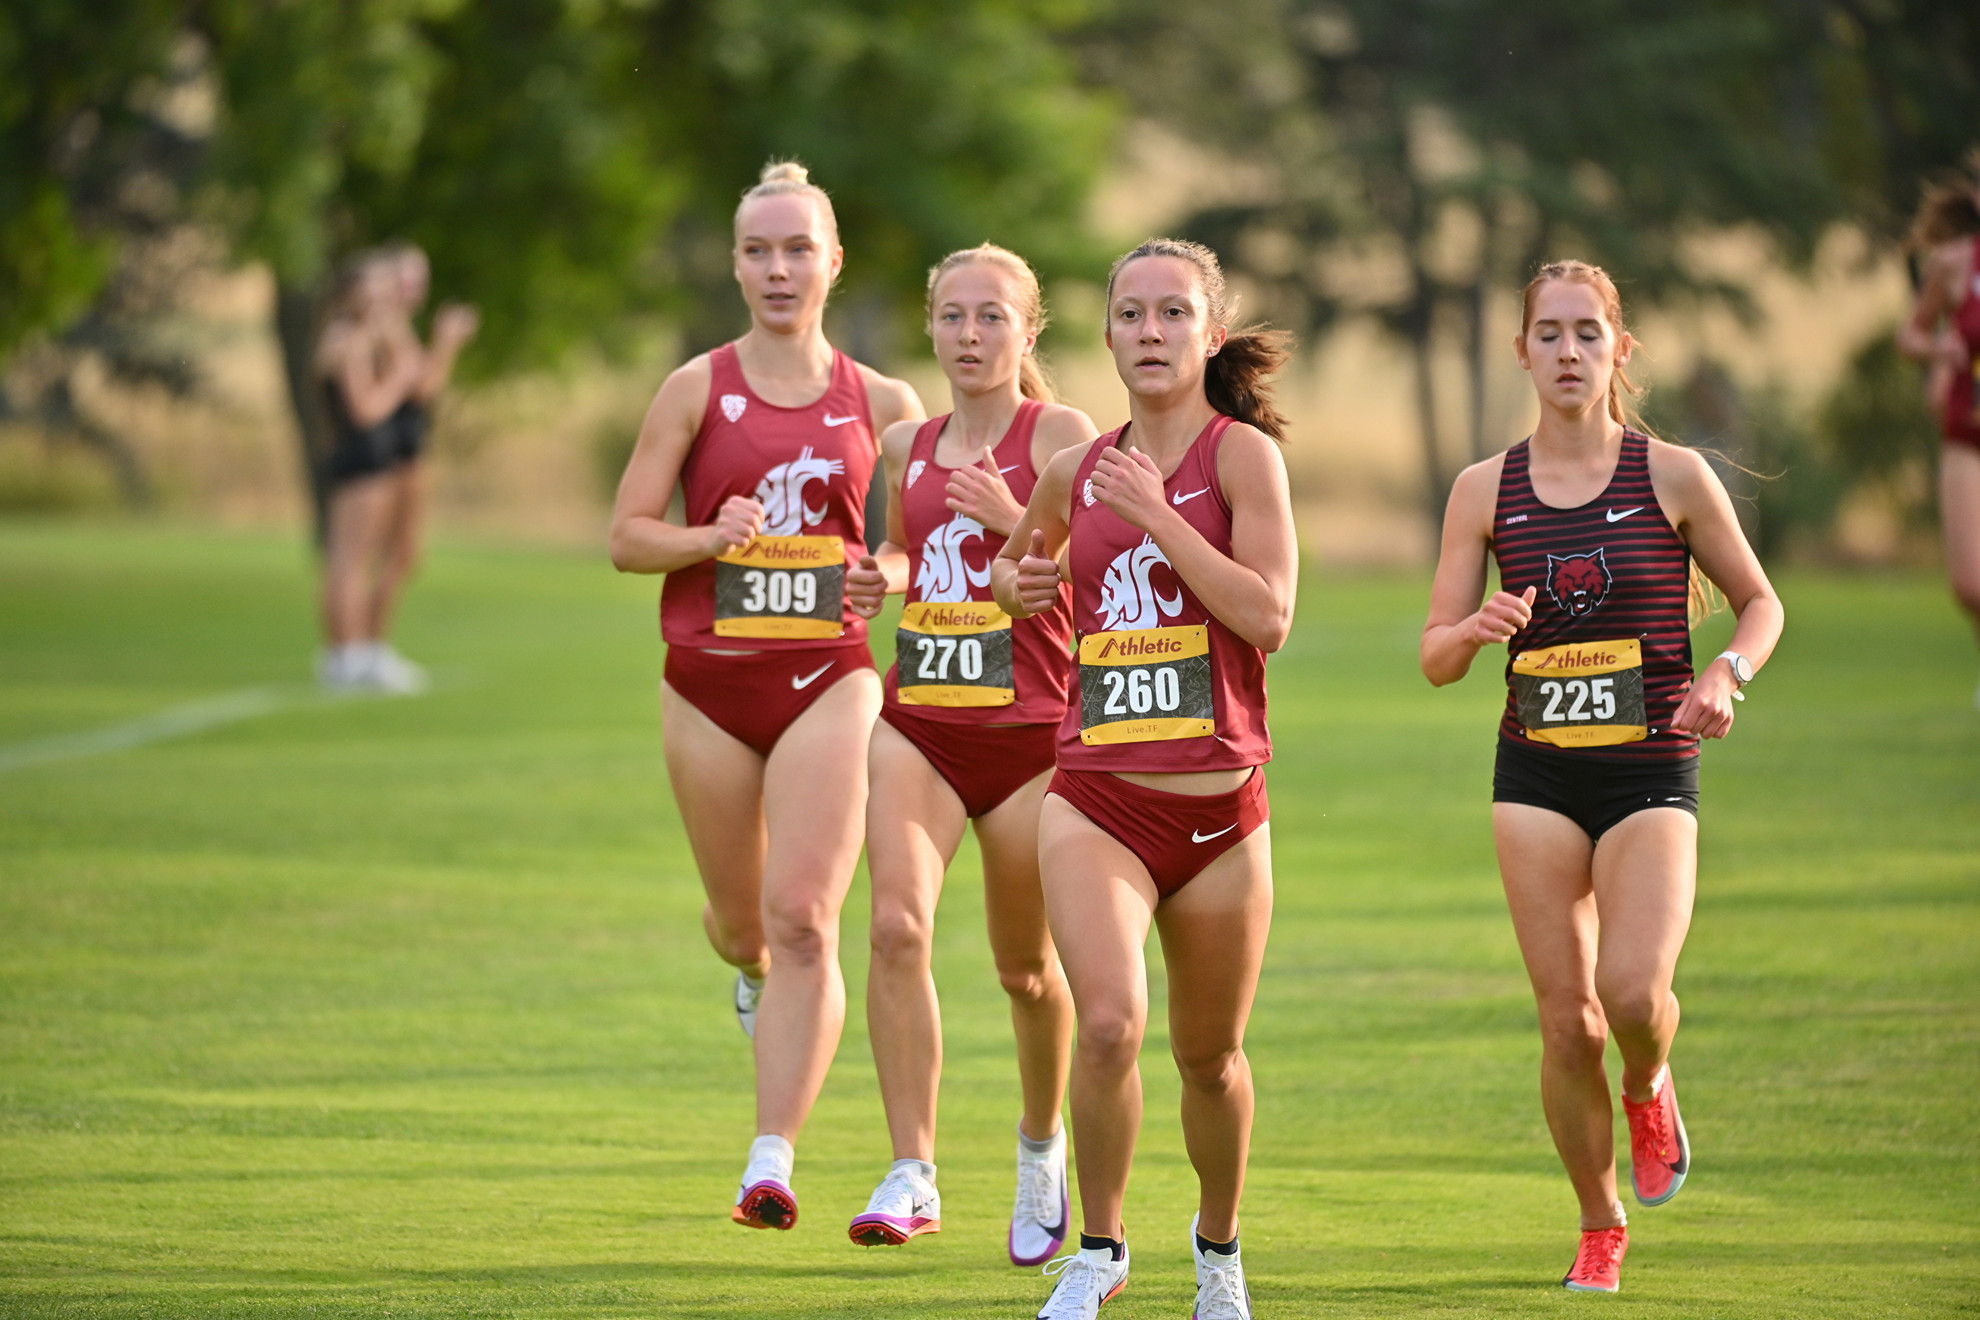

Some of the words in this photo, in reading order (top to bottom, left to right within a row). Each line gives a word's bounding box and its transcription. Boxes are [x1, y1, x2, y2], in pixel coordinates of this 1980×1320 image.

[743, 570, 817, 613] 309
[918, 608, 987, 626] Athletic
[917, 638, 983, 680] 270
[1098, 635, 1183, 659] Athletic
[1534, 649, 1617, 670] Athletic
[1103, 667, 1180, 715] 260
[1540, 678, 1616, 722] 225
[1126, 725, 1159, 735] Live.TF
